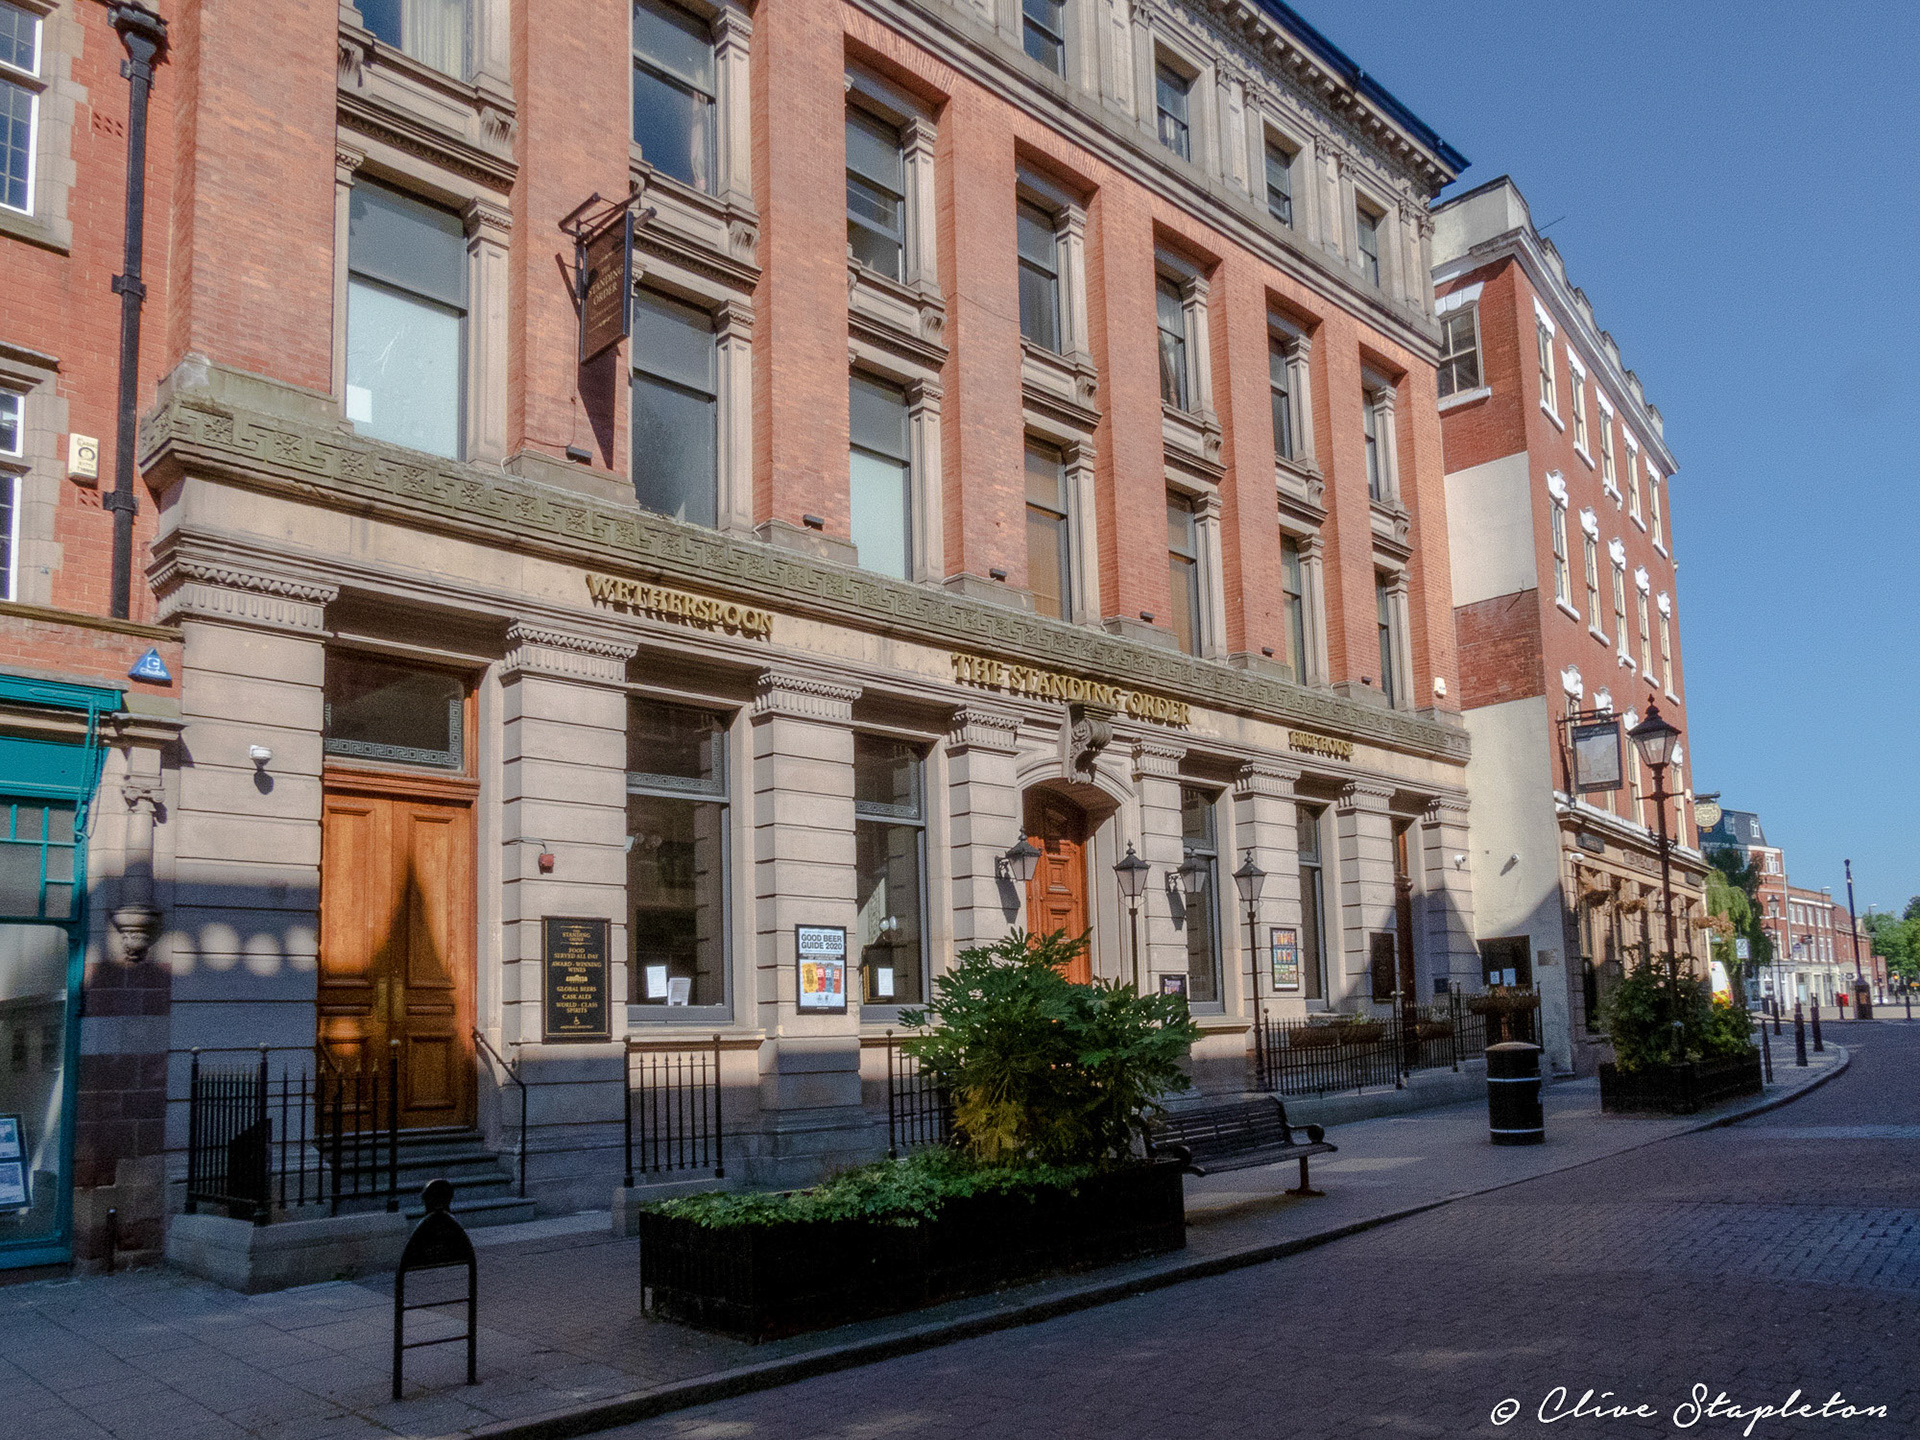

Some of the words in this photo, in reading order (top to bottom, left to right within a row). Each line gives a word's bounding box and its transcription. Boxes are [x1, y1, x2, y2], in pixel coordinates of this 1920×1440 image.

[585, 573, 776, 633] WETHERSPOON
[952, 652, 1005, 685] THE
[1009, 664, 1122, 707] STANDING
[1126, 691, 1192, 725] ORDER
[1288, 731, 1318, 750] FREE
[1318, 737, 1355, 757] HOUSE
